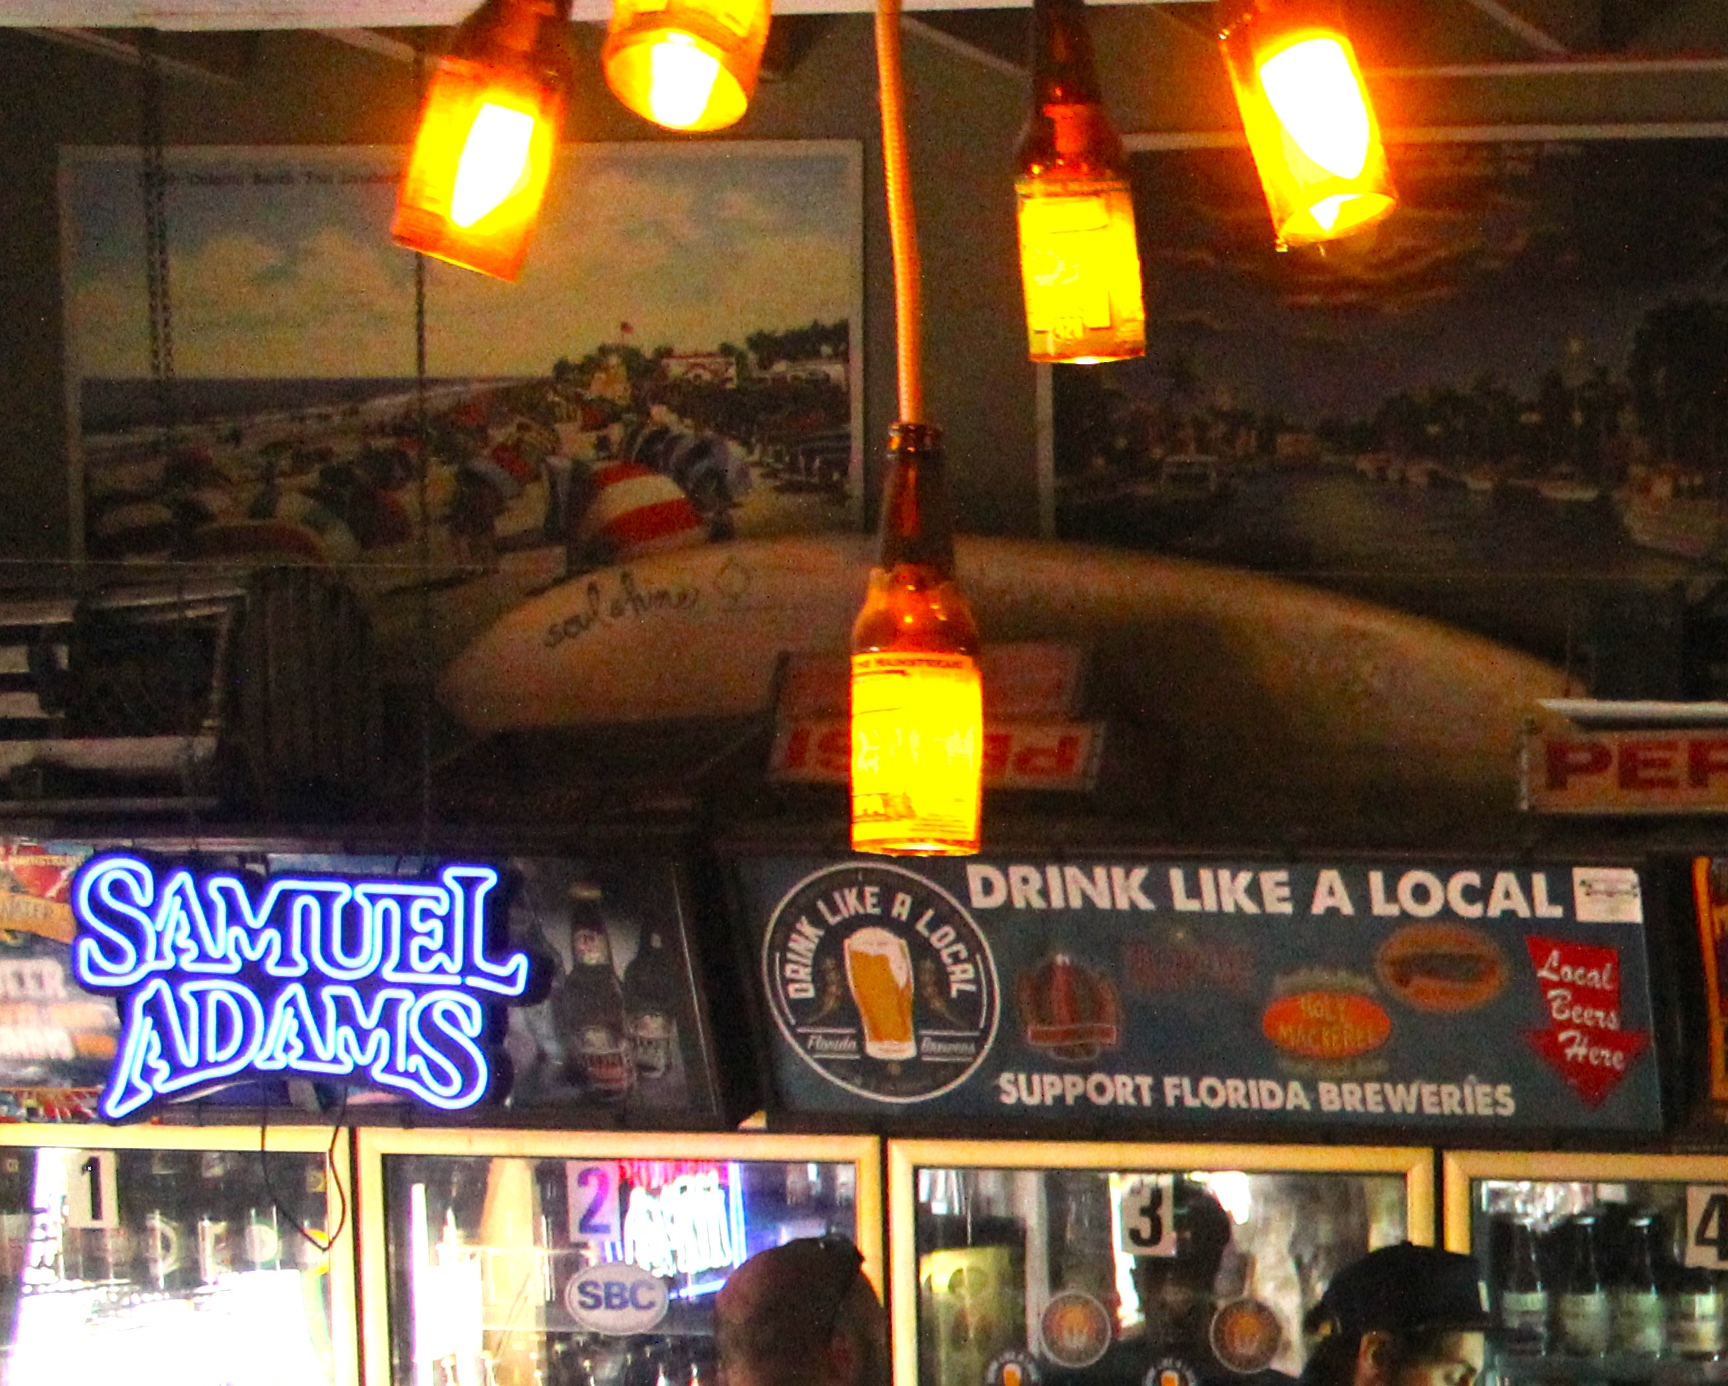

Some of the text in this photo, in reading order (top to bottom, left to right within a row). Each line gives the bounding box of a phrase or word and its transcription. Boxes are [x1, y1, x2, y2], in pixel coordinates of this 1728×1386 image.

[966, 864, 1155, 911] DRINK
[1169, 868, 1294, 914] LIKE
[1309, 869, 1355, 915] A
[1368, 869, 1564, 918] LOCAL
[74, 853, 529, 996] SAMUEL
[784, 886, 977, 999] DRINK LIKE A LOCAL
[1537, 950, 1614, 991] Local
[1547, 988, 1621, 1030] Beers
[101, 978, 490, 1119] ADAMS
[1558, 1029, 1626, 1069] Here
[999, 1071, 1516, 1117] SUPPORT FLORIDA BREWERIES
[81, 1156, 102, 1221] 1
[576, 1166, 611, 1234] 2
[1128, 1184, 1164, 1248] 3
[576, 1279, 656, 1311] SBC
